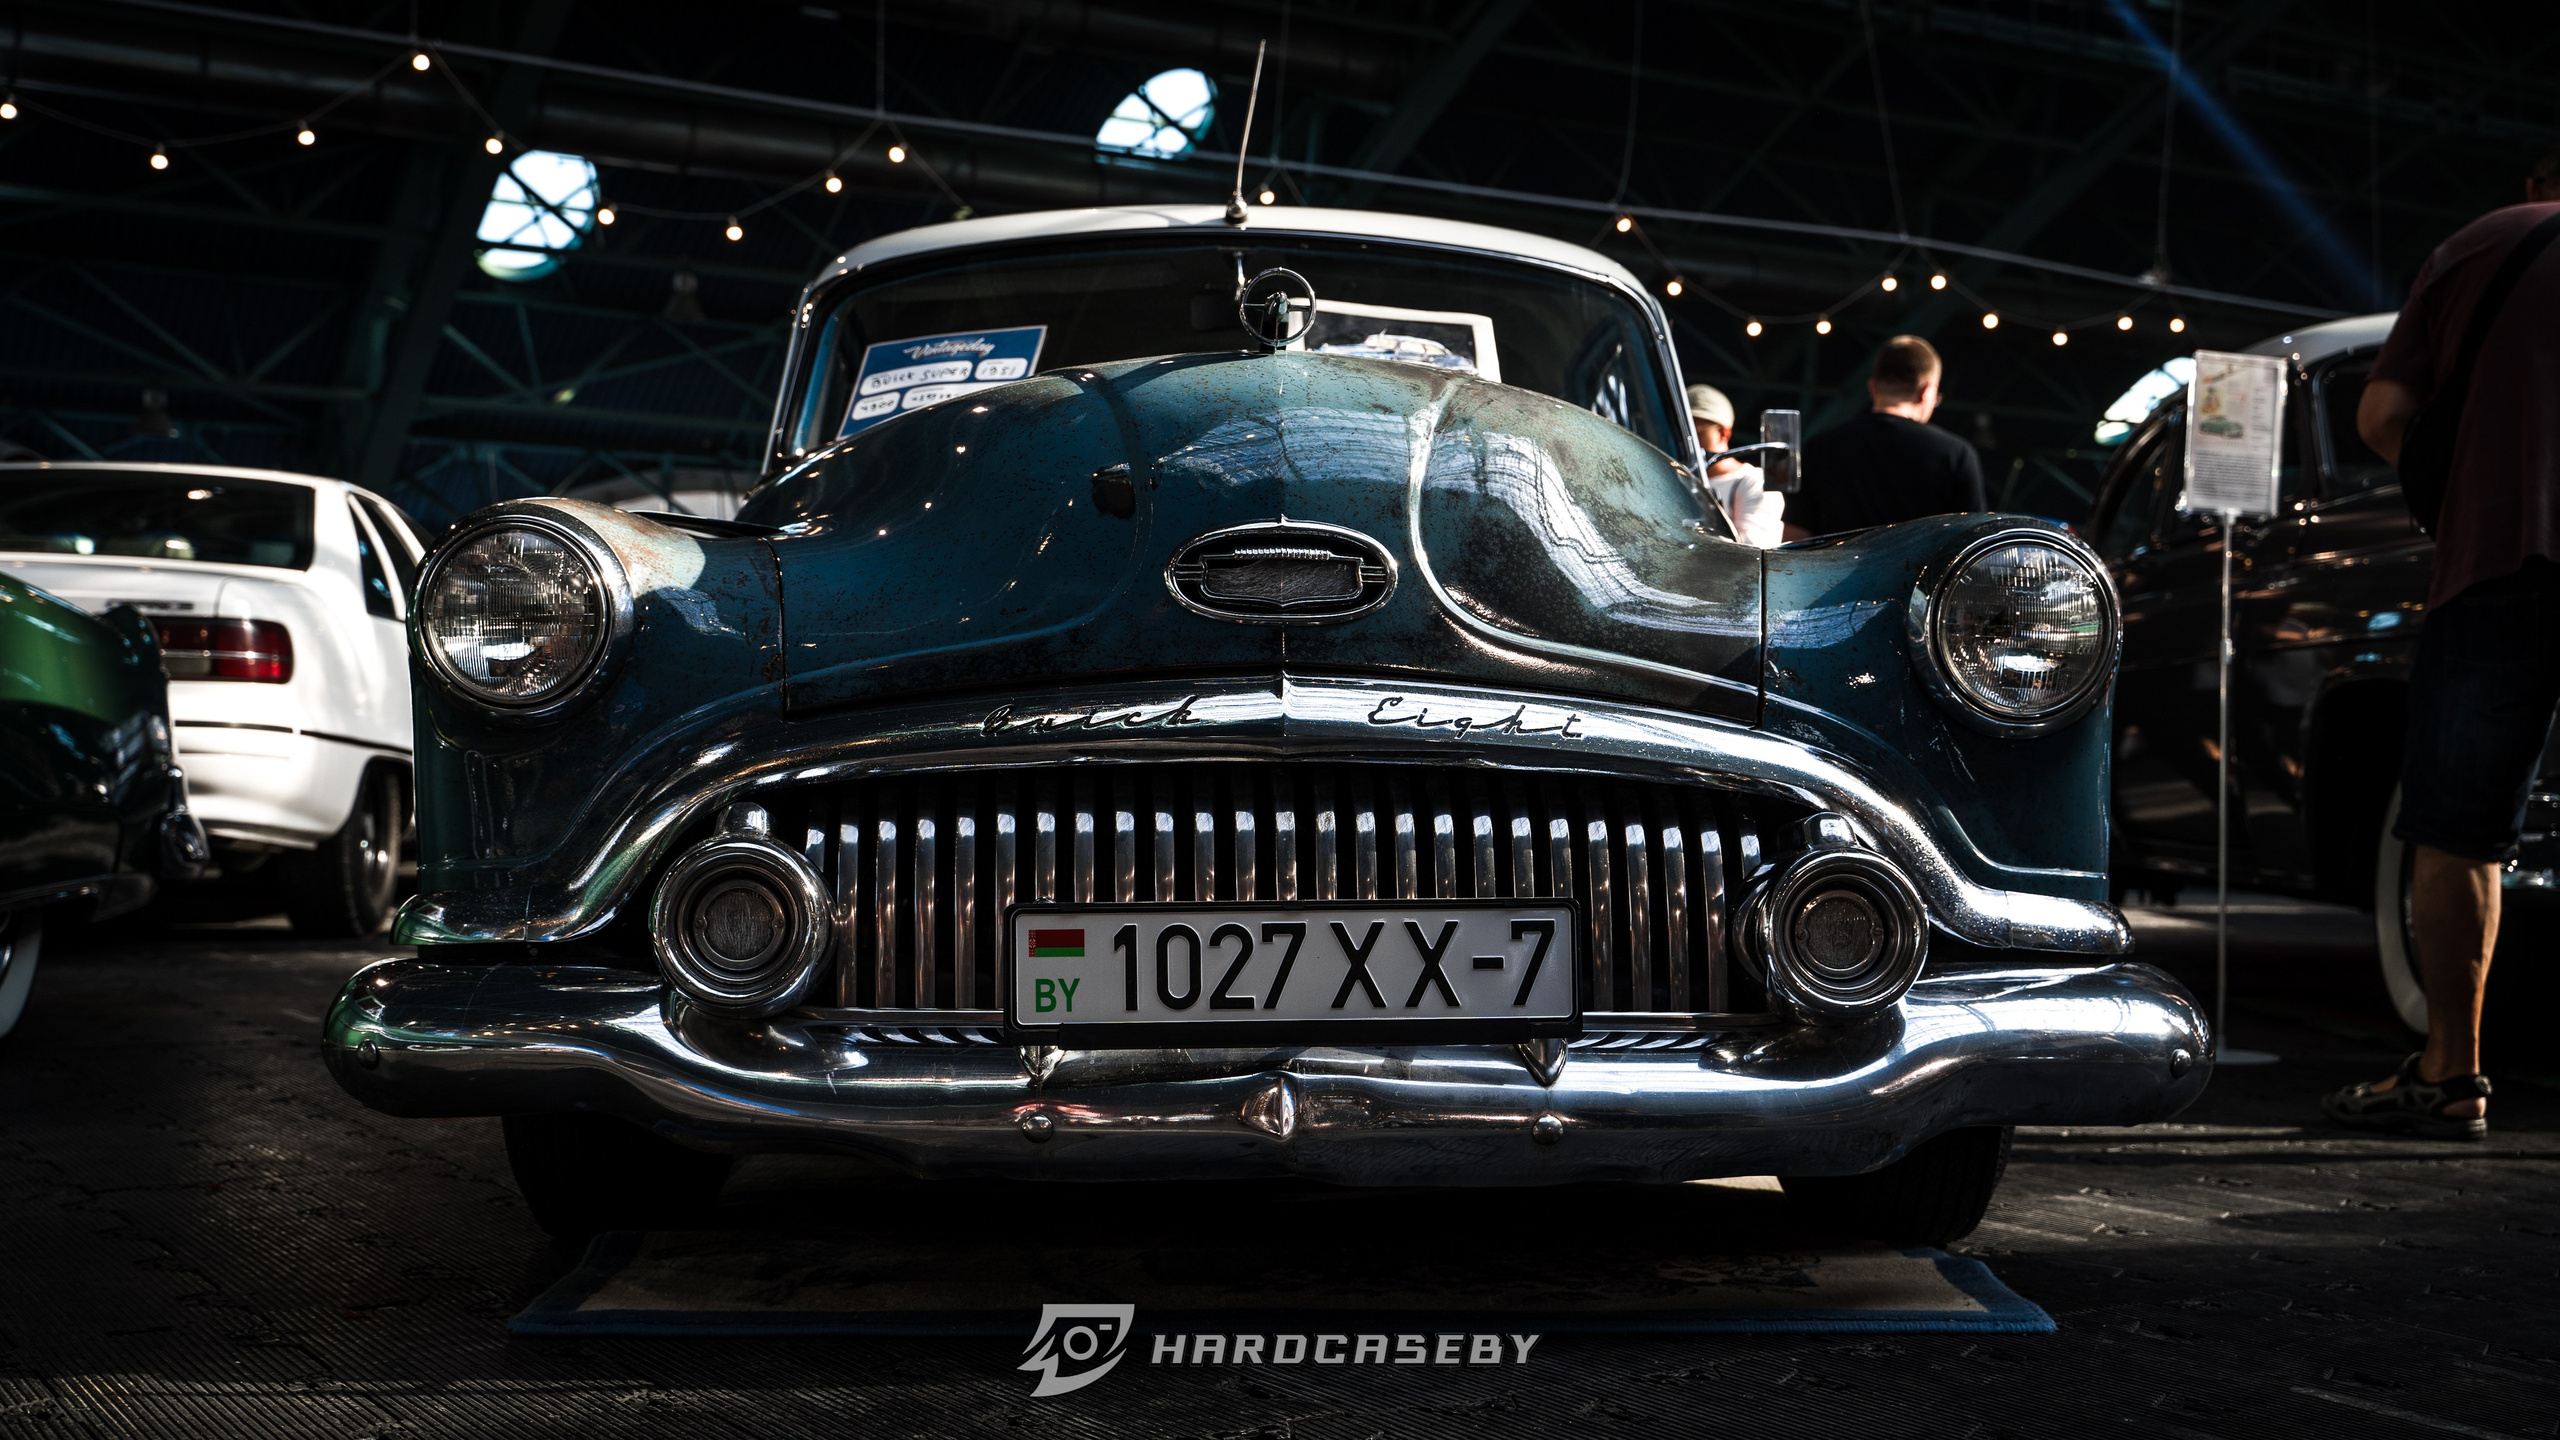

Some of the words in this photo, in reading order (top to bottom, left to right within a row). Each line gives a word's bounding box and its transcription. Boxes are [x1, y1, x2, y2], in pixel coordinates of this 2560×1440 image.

[981, 366, 1017, 377] 1951
[980, 694, 1201, 738] Buick
[1367, 696, 1583, 740] Eight
[1113, 922, 1307, 1011] 1027
[1034, 977, 1081, 1014] BY
